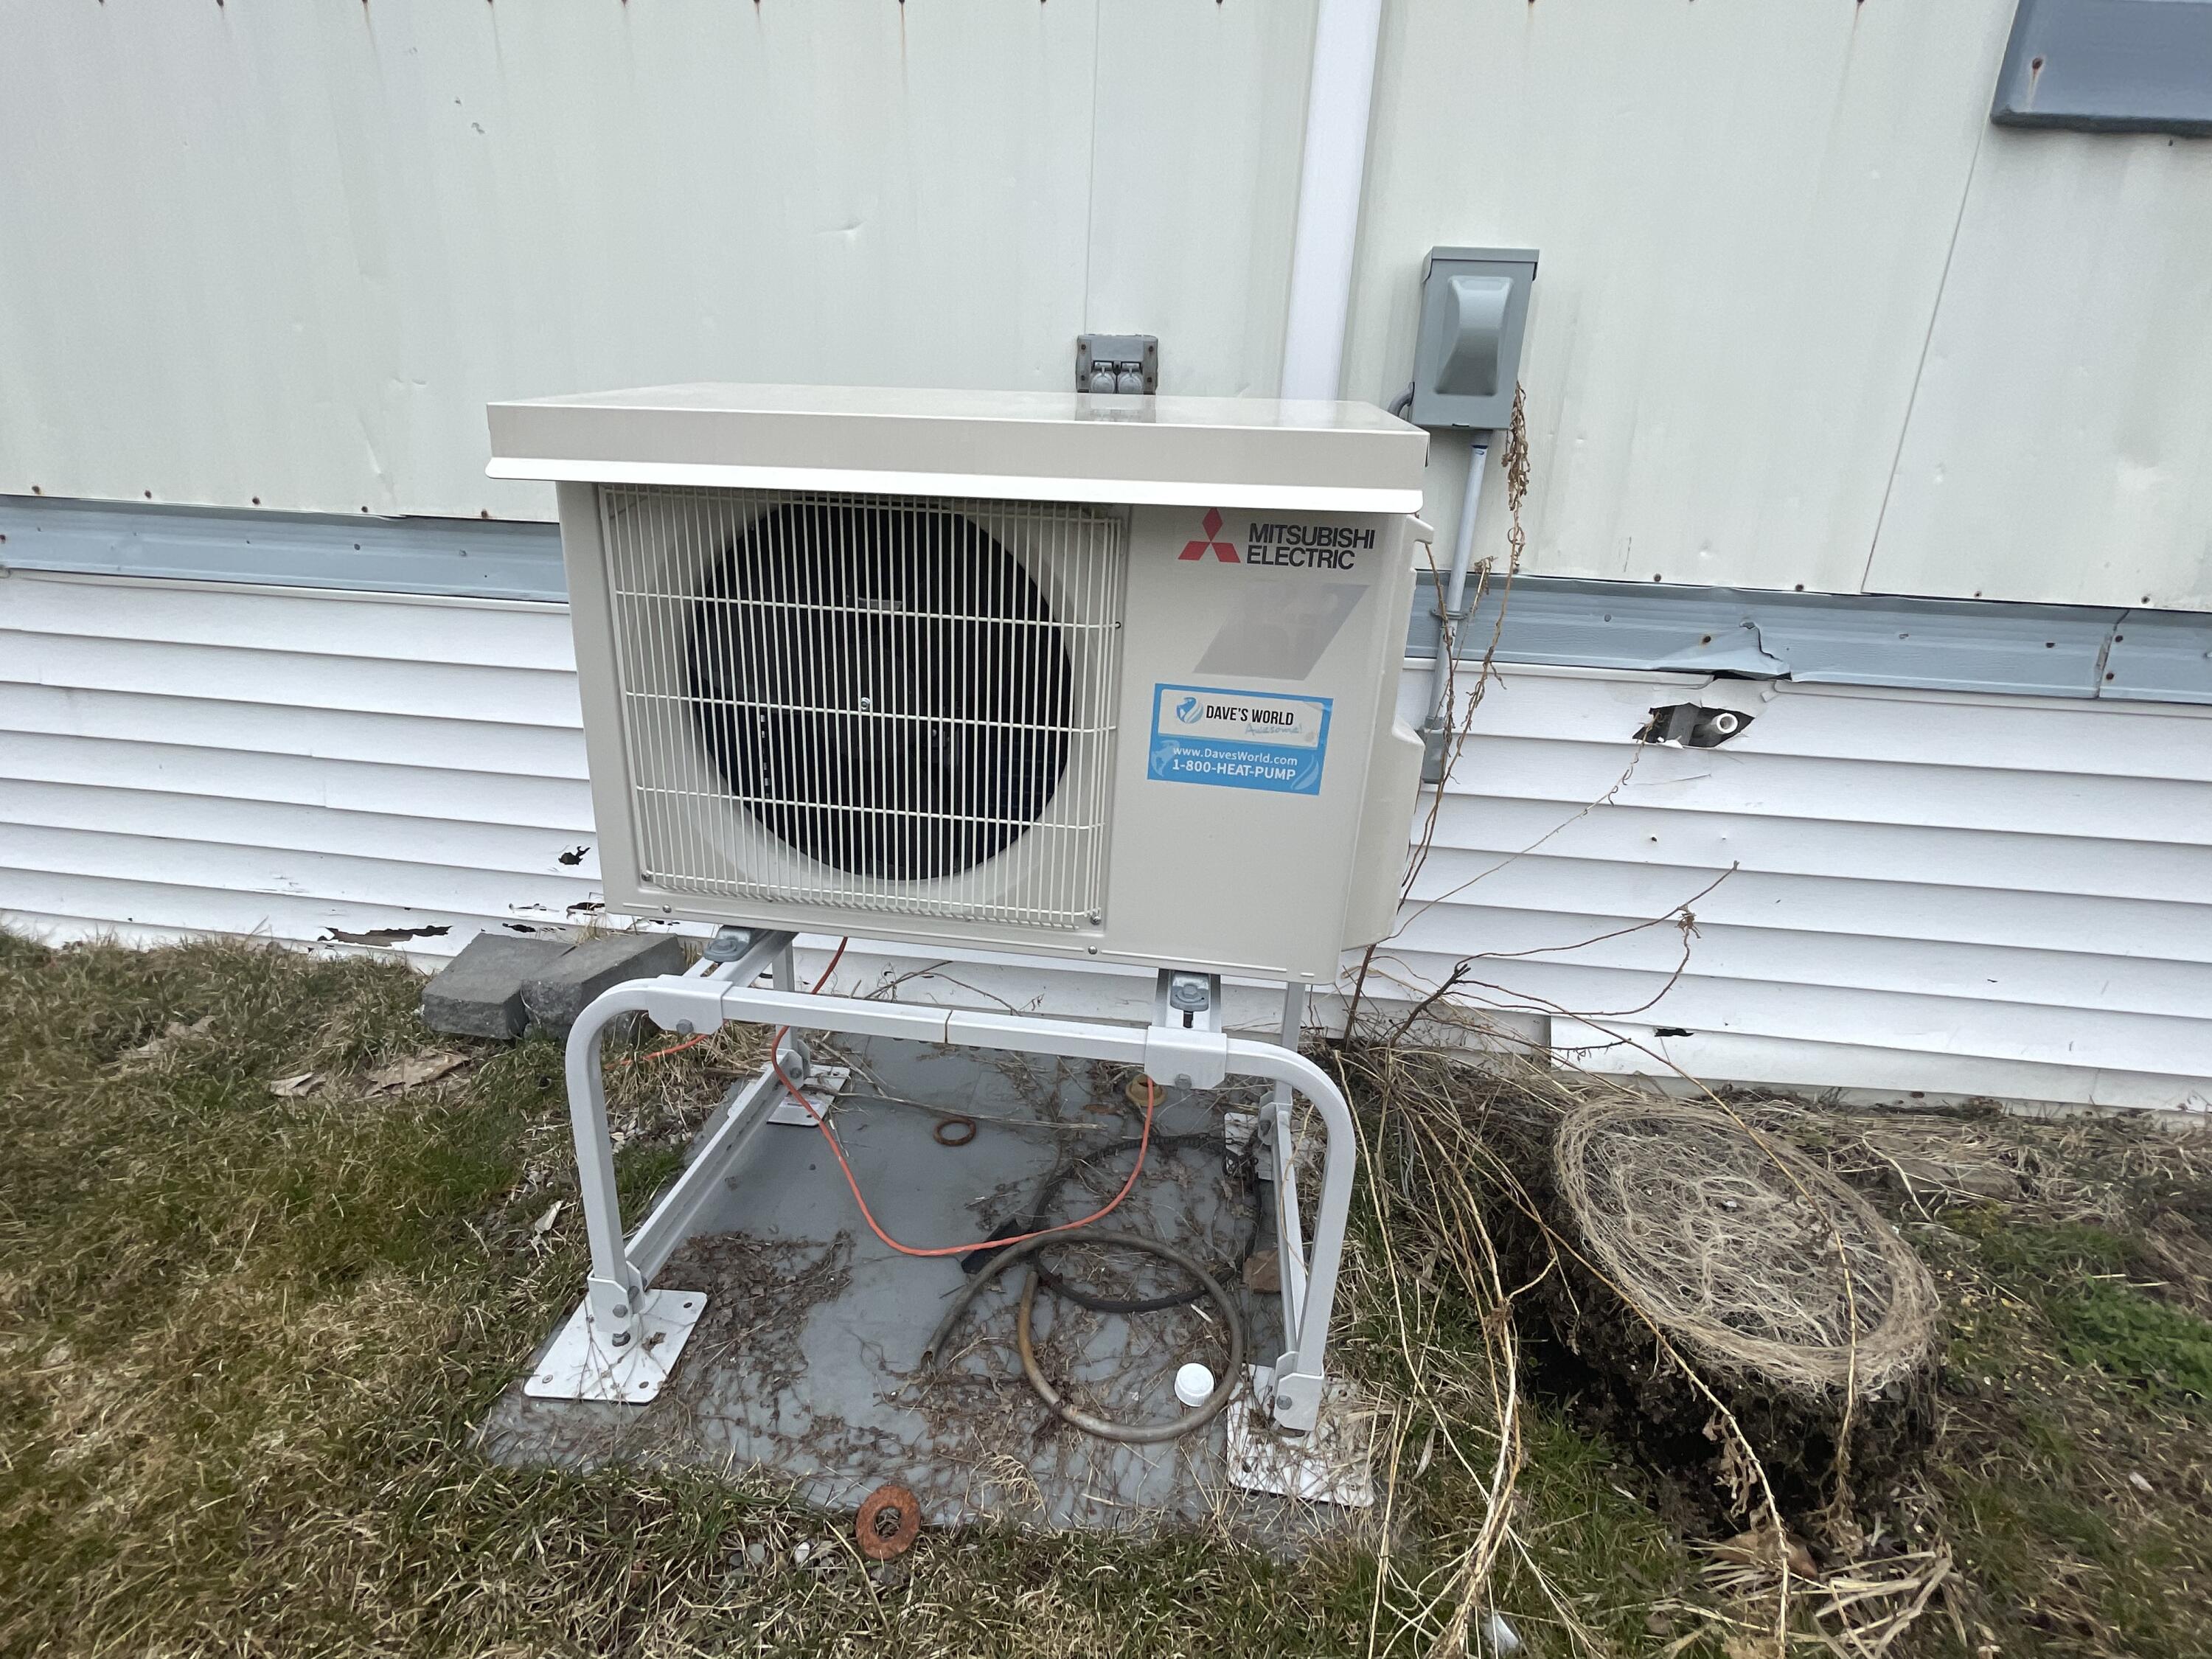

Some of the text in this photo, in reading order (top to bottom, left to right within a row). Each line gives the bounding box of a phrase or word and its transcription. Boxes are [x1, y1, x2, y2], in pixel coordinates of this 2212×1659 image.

[1248, 523, 1375, 549] MITSUBISHI
[1246, 545, 1355, 569] ELECTRIC
[1206, 705, 1294, 726] DAVE'S WORLD
[1173, 746, 1298, 765] www.DavesWorld.com
[1172, 759, 1296, 781] 1-800-HEAT-PUMP
